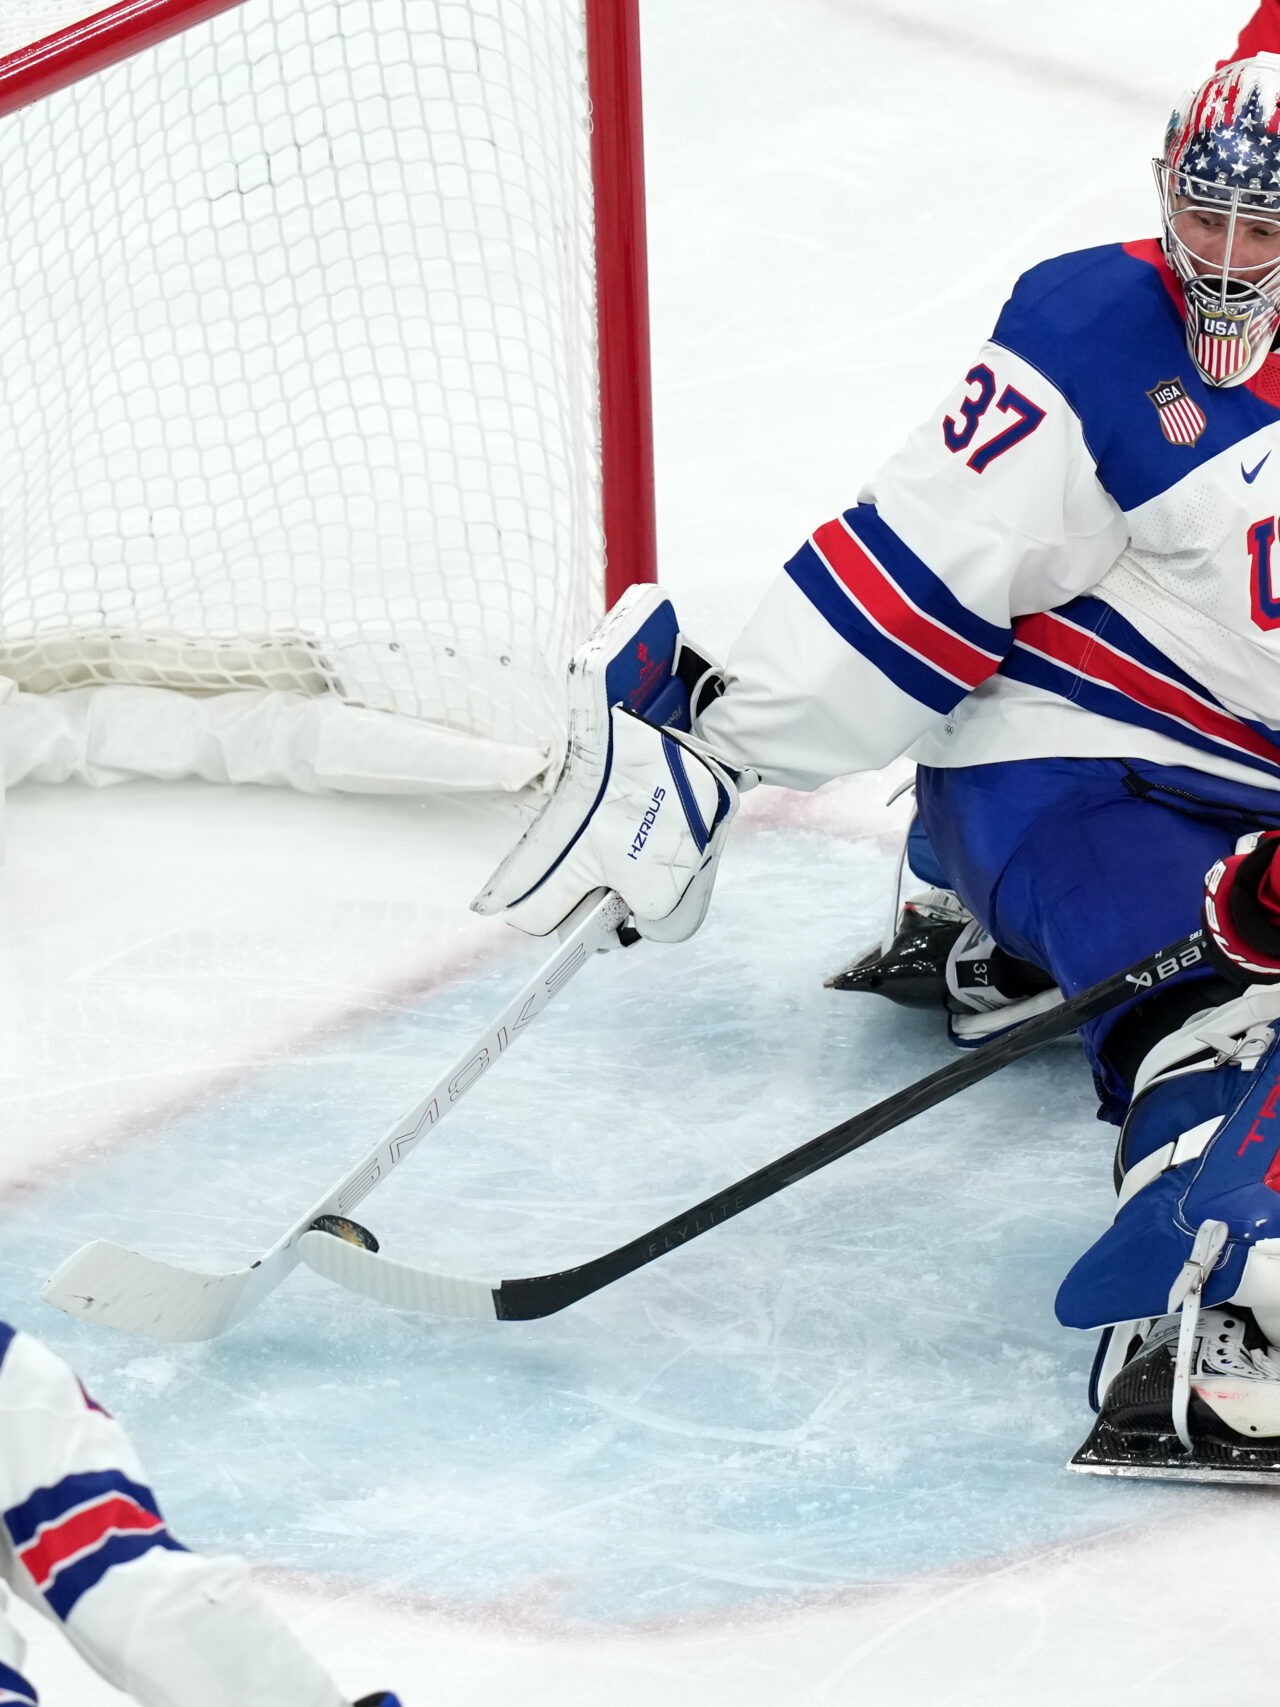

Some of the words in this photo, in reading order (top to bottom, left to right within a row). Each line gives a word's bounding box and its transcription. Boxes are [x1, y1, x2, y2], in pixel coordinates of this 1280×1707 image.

[1204, 318, 1238, 336] USA
[1154, 385, 1182, 405] USA
[942, 362, 1047, 475] 37
[627, 786, 667, 860] HZRDUS
[973, 962, 988, 986] 37
[648, 1195, 745, 1257] FLYLITE
